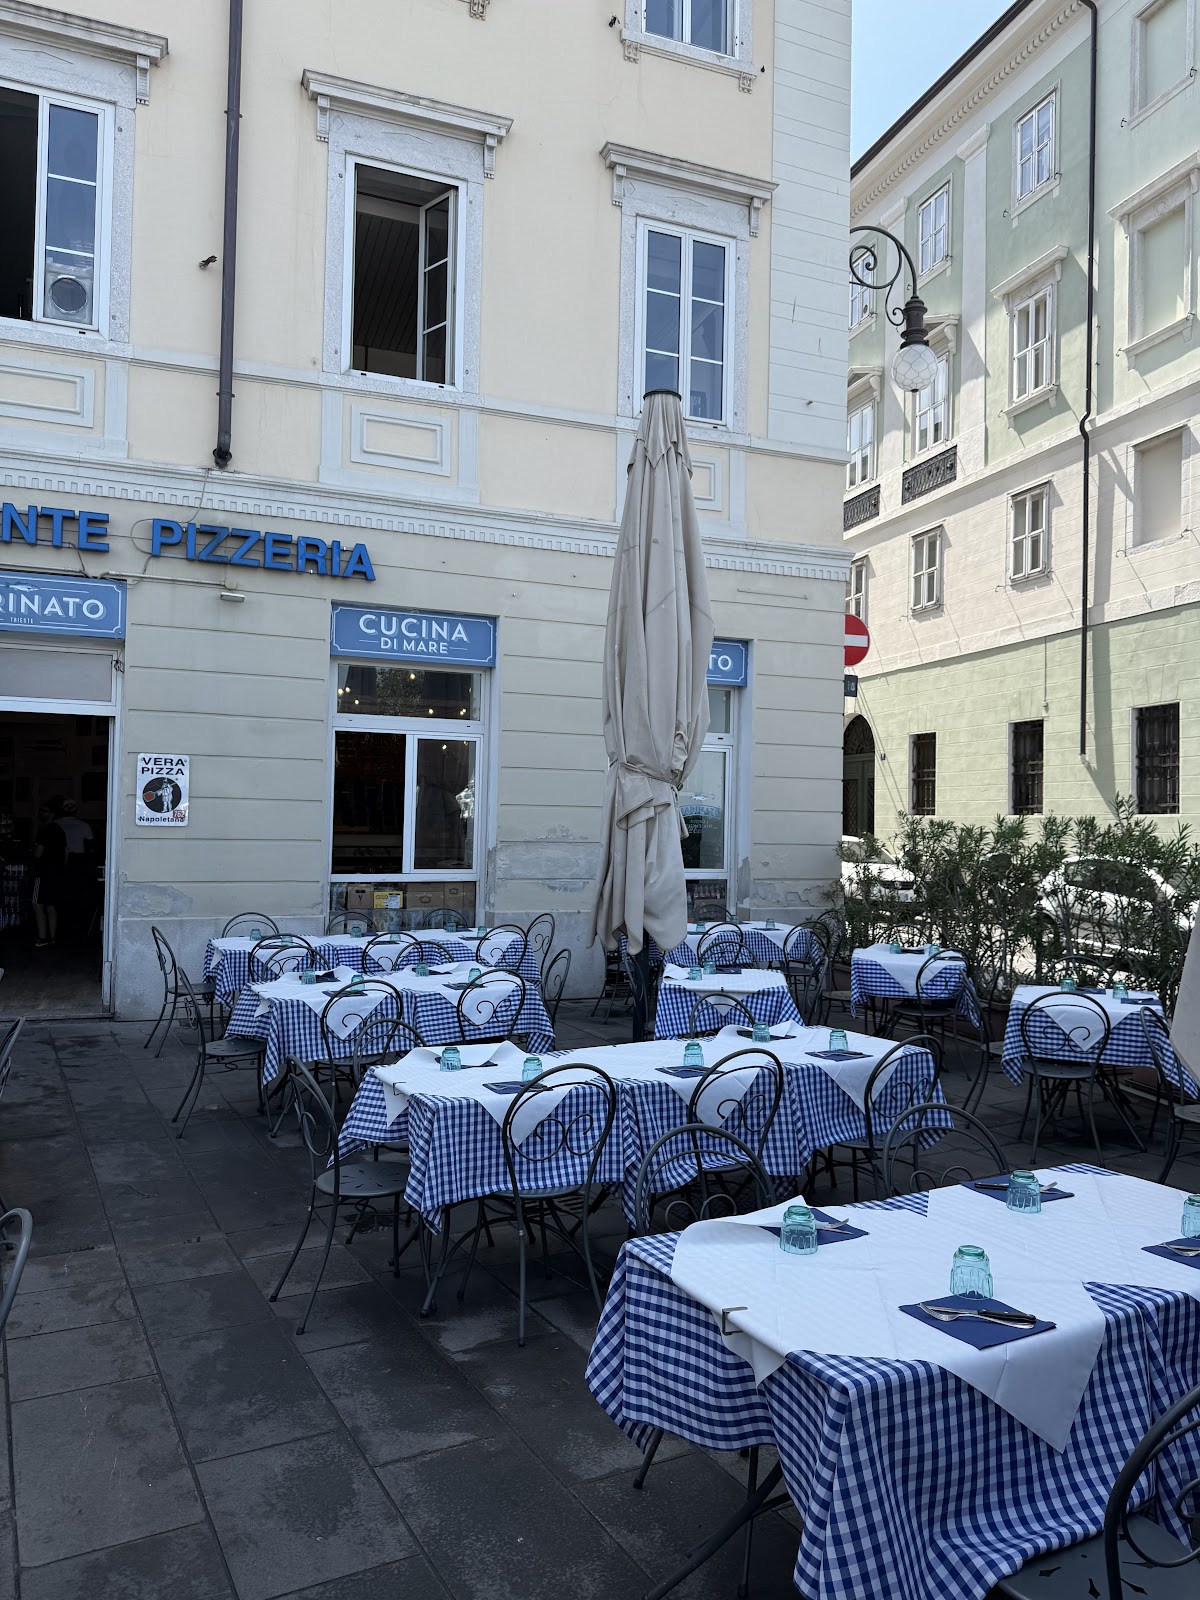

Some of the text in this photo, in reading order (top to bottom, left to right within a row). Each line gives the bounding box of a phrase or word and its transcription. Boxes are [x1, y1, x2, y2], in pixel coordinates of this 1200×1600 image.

[1, 502, 377, 582] NTE PIZZERIA
[0, 592, 105, 620] INATO
[10, 616, 34, 624] TRIESTE
[358, 614, 469, 642] CUCINA
[380, 637, 449, 654] DI MARE
[708, 654, 733, 671] TO
[142, 757, 186, 767] VERA
[141, 766, 185, 776] PIZZA
